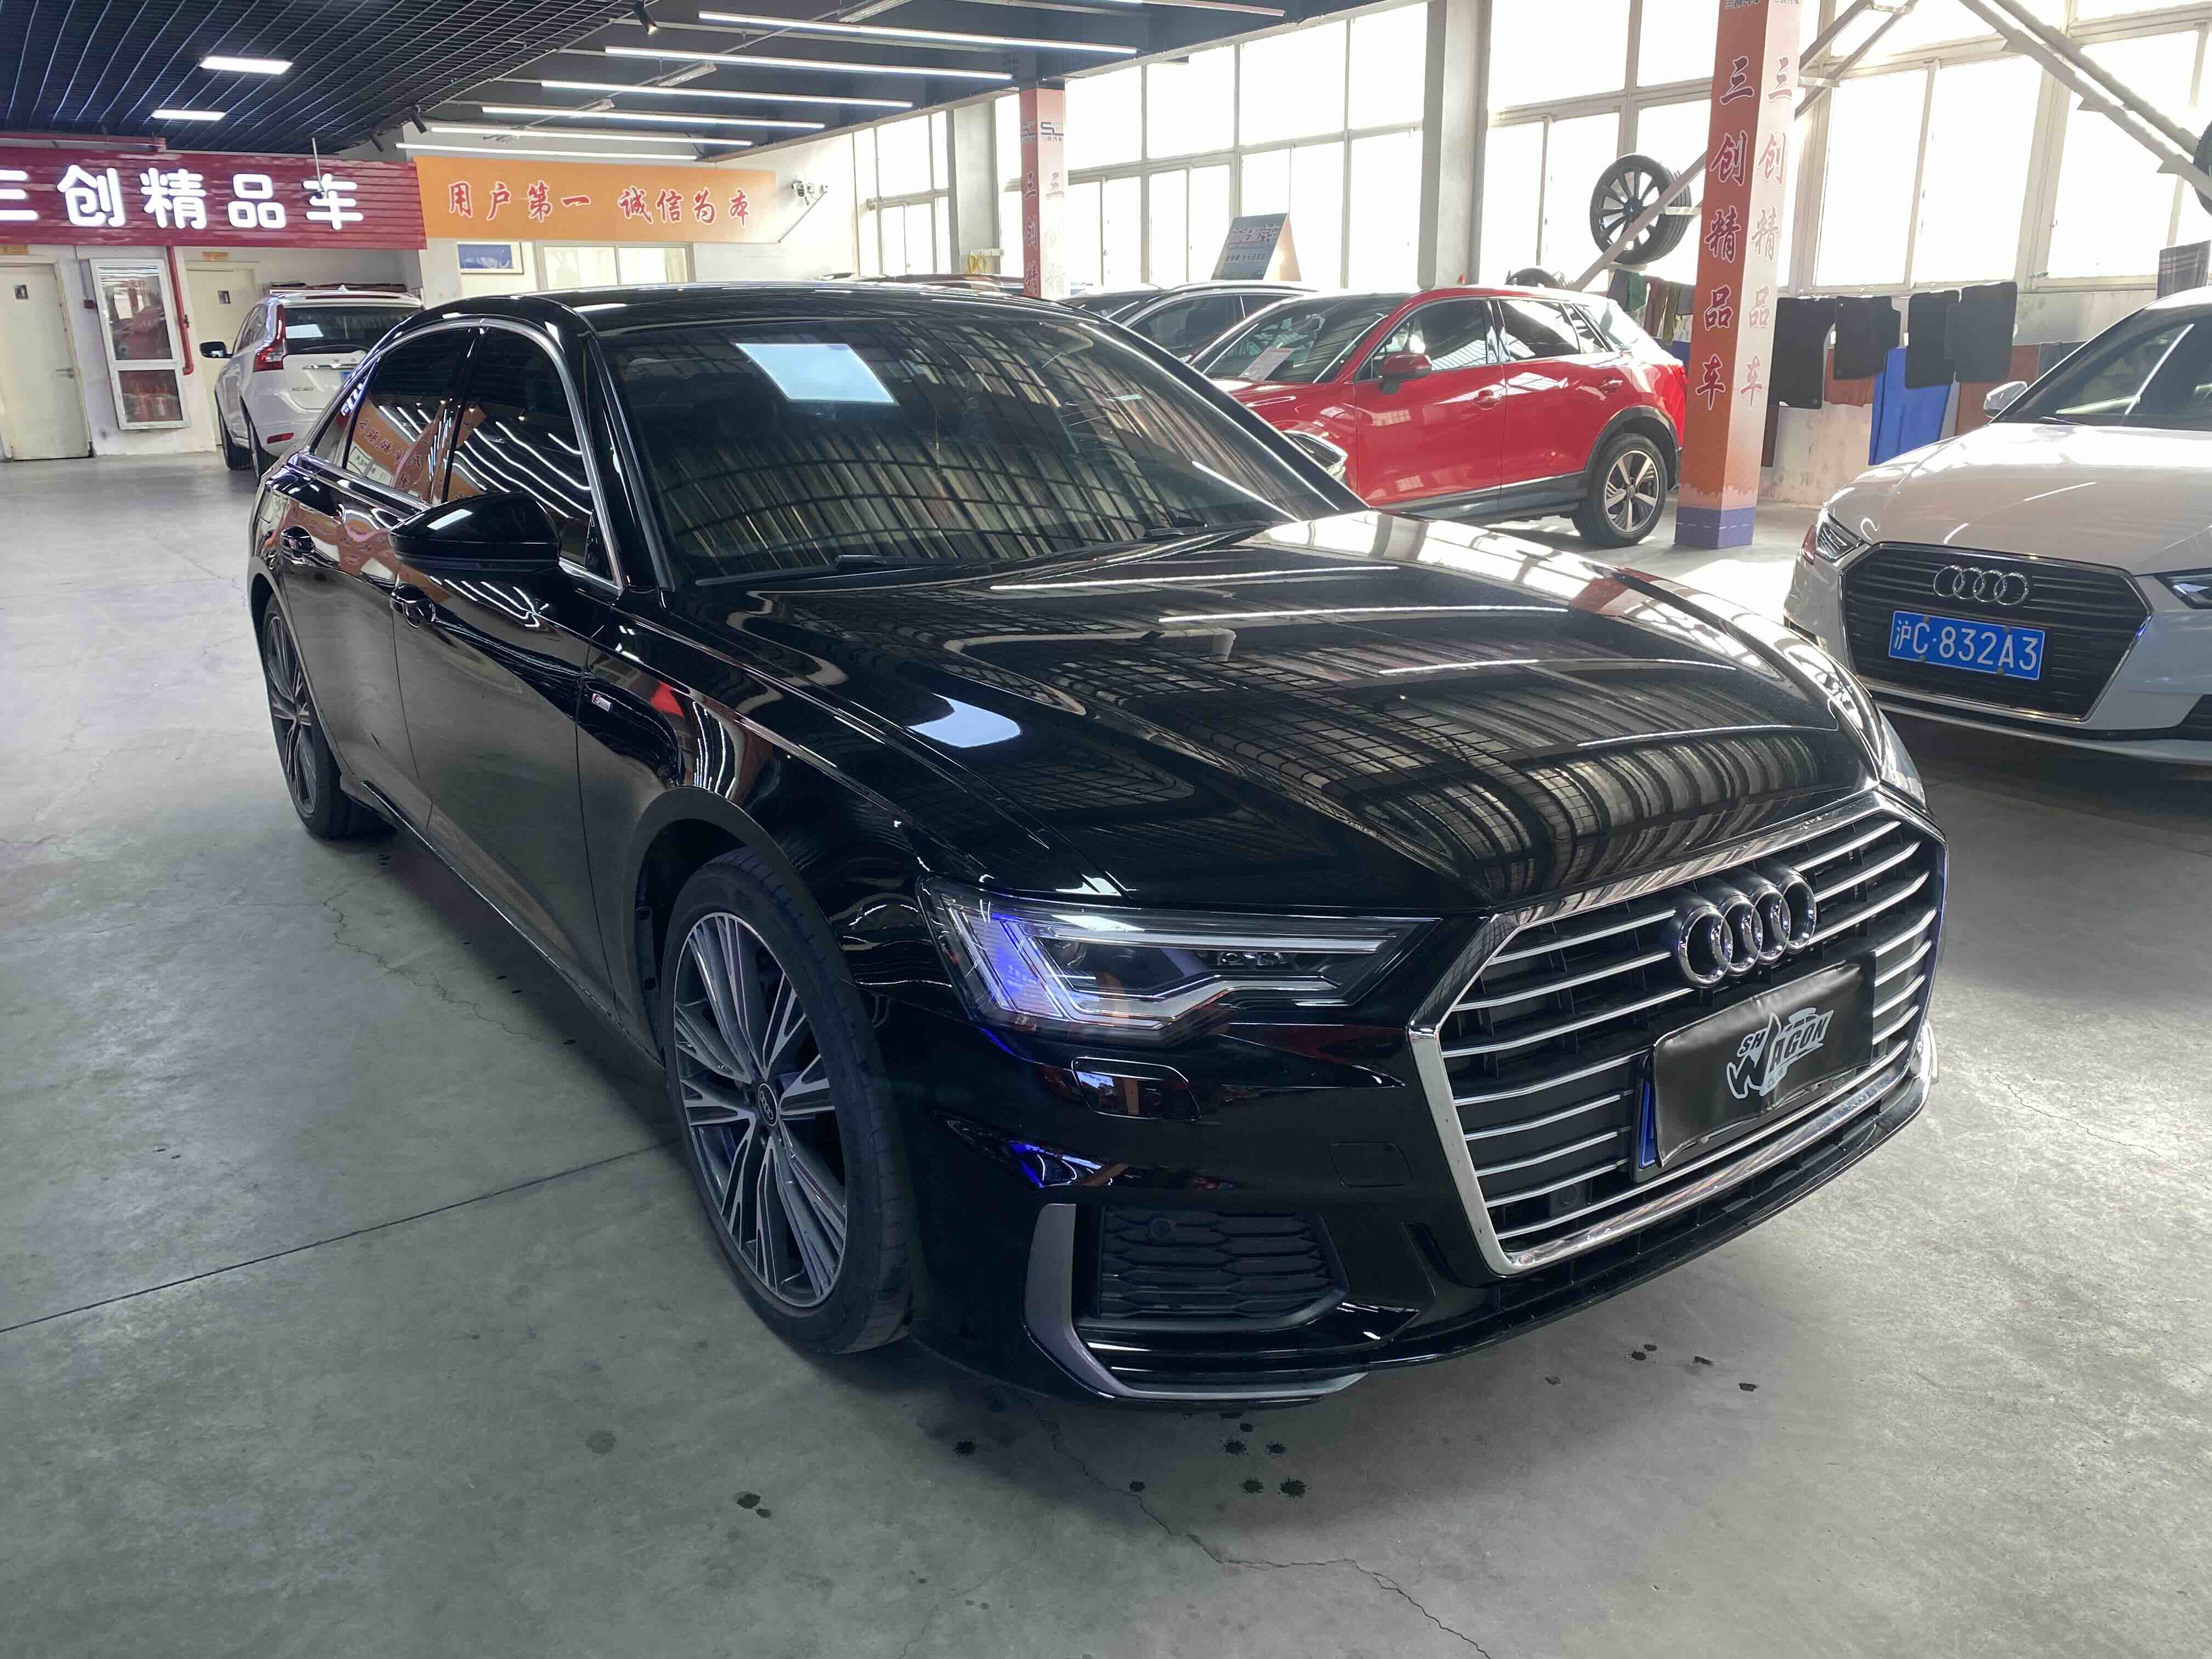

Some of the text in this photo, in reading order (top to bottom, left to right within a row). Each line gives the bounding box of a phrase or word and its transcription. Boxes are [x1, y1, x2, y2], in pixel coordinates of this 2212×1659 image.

[448, 180, 752, 227] 用户第一 诚信为本
[1695, 56, 1755, 410] 三创精品车
[1739, 57, 1793, 410] 三创精品车
